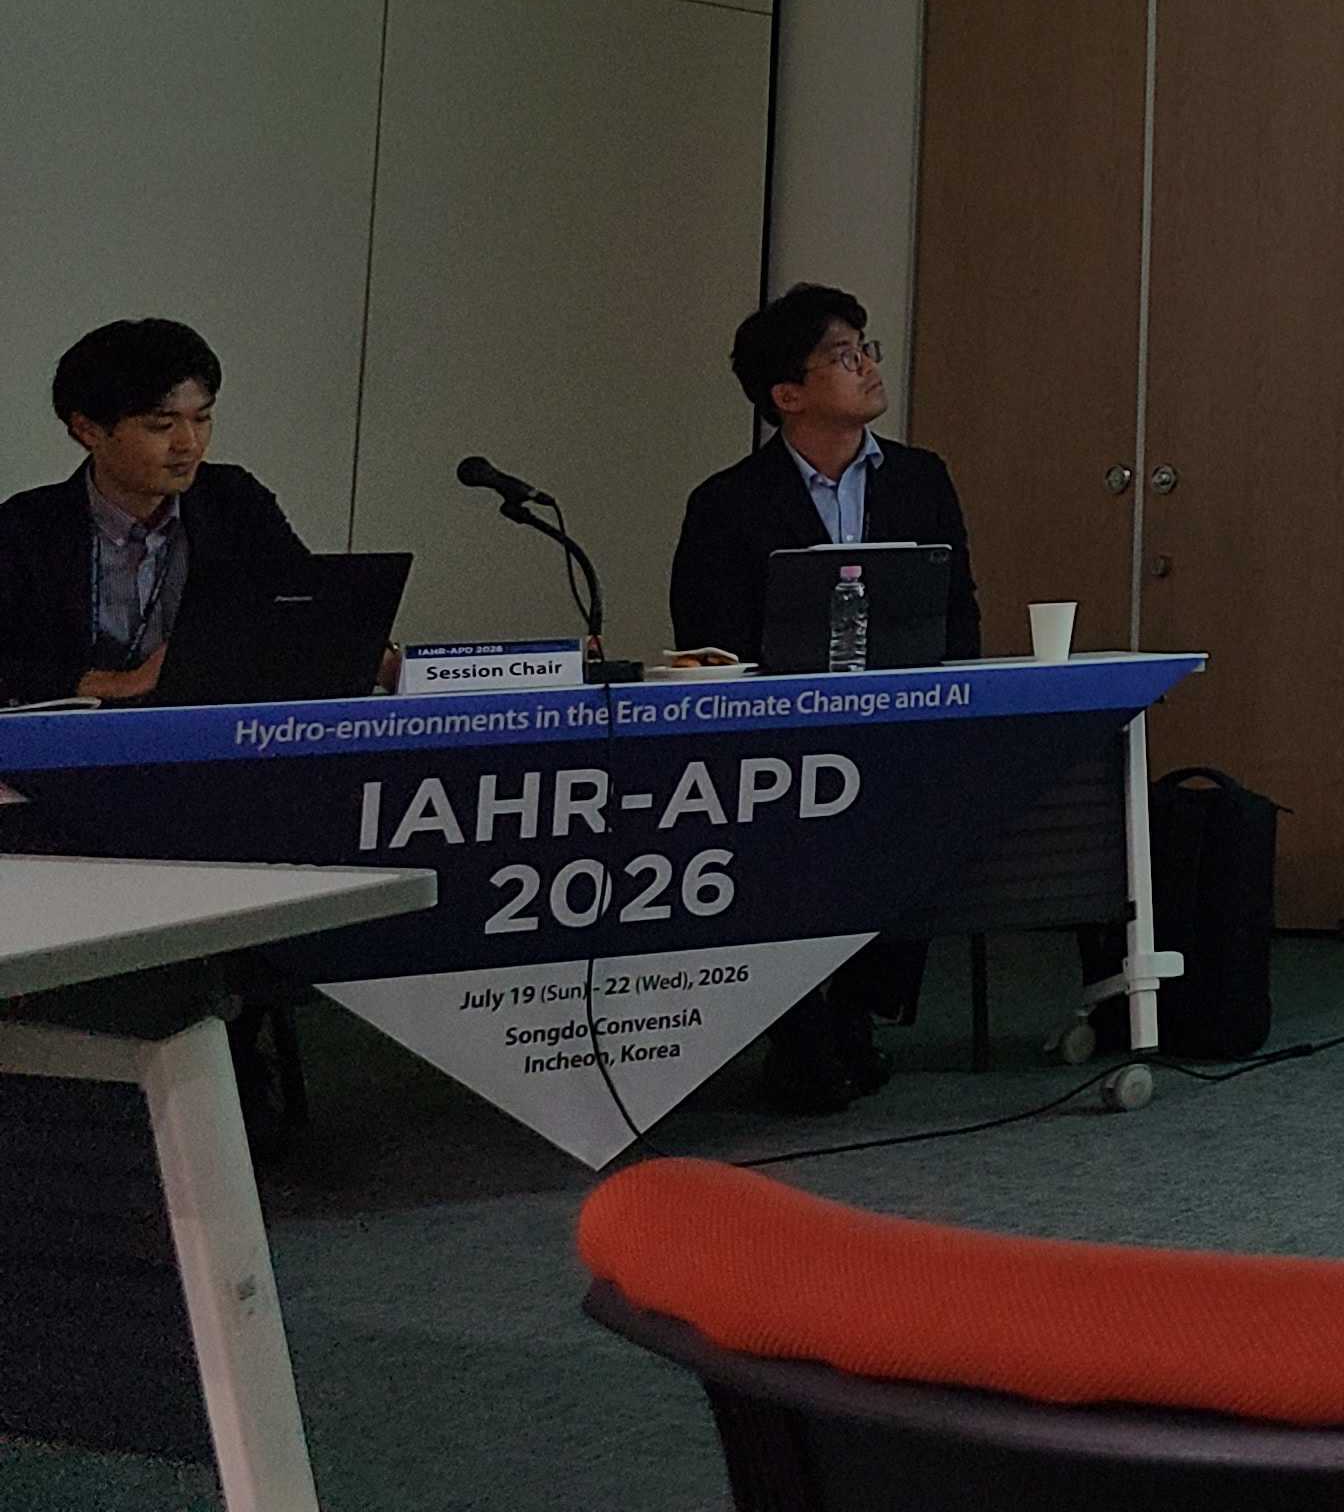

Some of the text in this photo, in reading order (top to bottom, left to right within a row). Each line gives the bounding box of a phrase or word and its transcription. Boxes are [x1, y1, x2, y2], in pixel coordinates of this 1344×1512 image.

[426, 660, 563, 680] Session Chair
[235, 682, 970, 751] Hydro-environments in the Era of Climate Change and AI
[358, 753, 861, 851] IAHR-APD
[484, 848, 736, 936] 2026
[460, 965, 749, 1012] July 19 (Sun) 22 (Wed), 2026
[505, 1008, 702, 1048] Songdo ConvensiA
[620, 1043, 681, 1064] Korea
